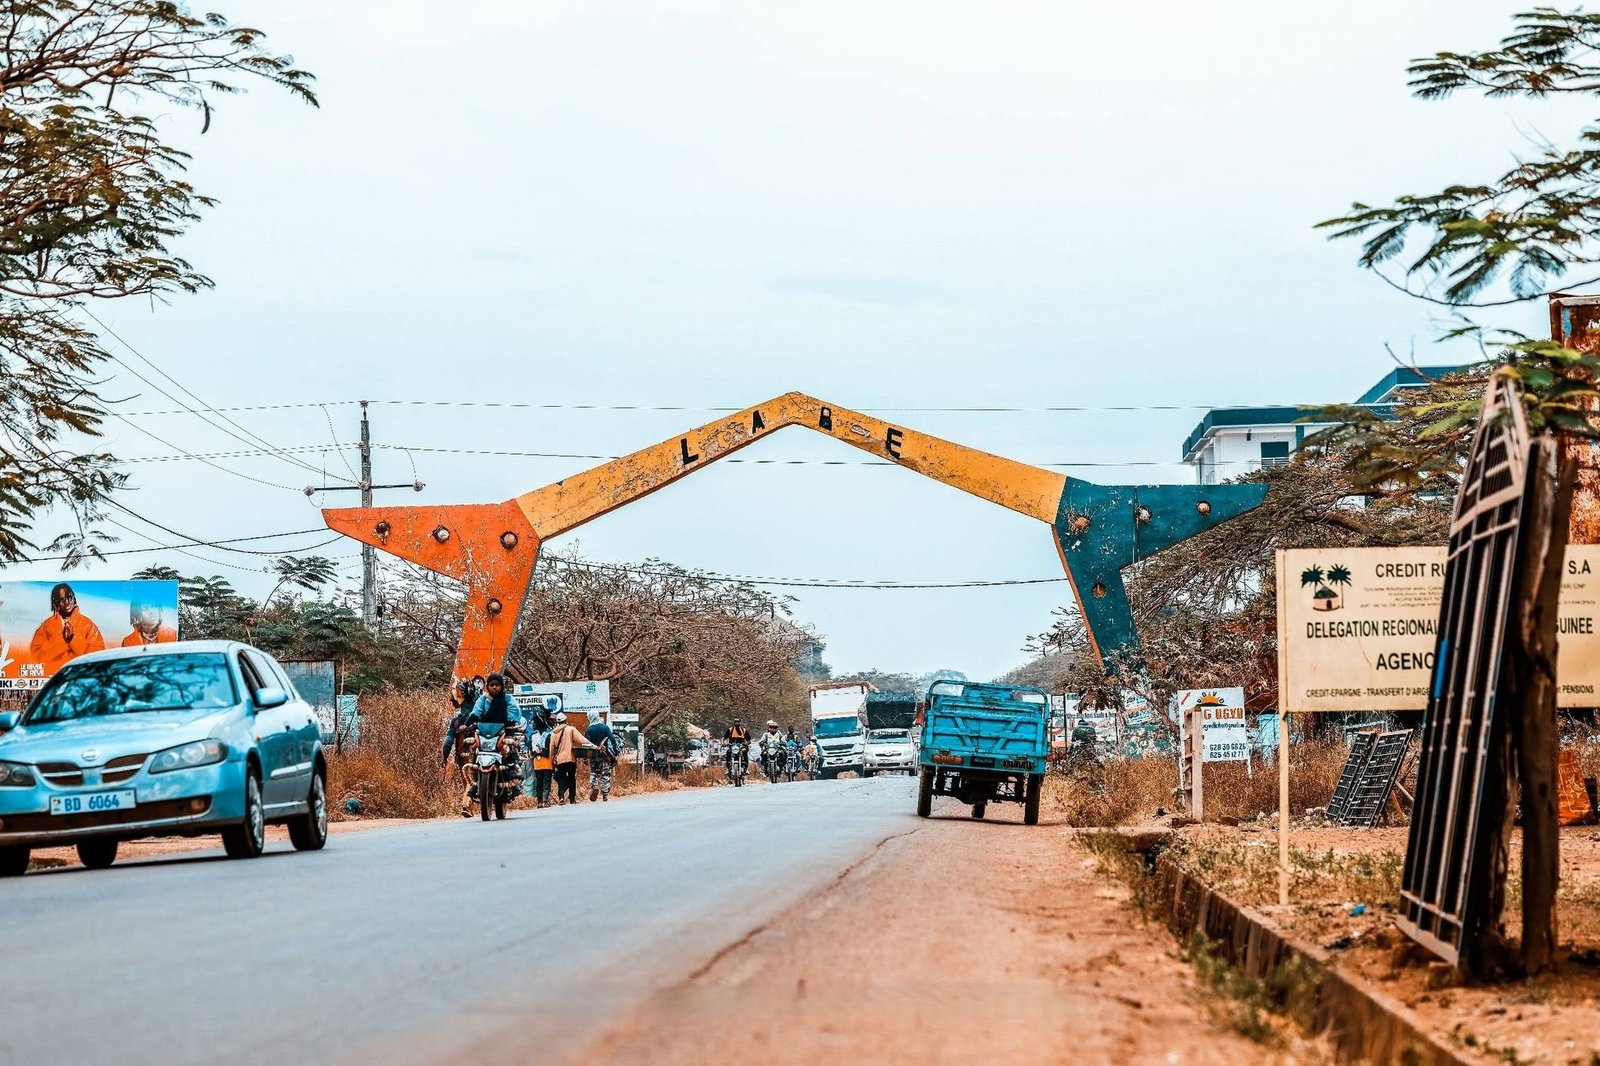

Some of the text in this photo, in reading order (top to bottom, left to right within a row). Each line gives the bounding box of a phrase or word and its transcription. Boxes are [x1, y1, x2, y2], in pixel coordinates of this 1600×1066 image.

[1375, 563, 1427, 578] CREDIT
[1568, 559, 1592, 575] S.A
[1307, 620, 1379, 638] DELEGATION
[1562, 684, 1595, 694] PENSIONS
[64, 794, 120, 812] BD 6064
